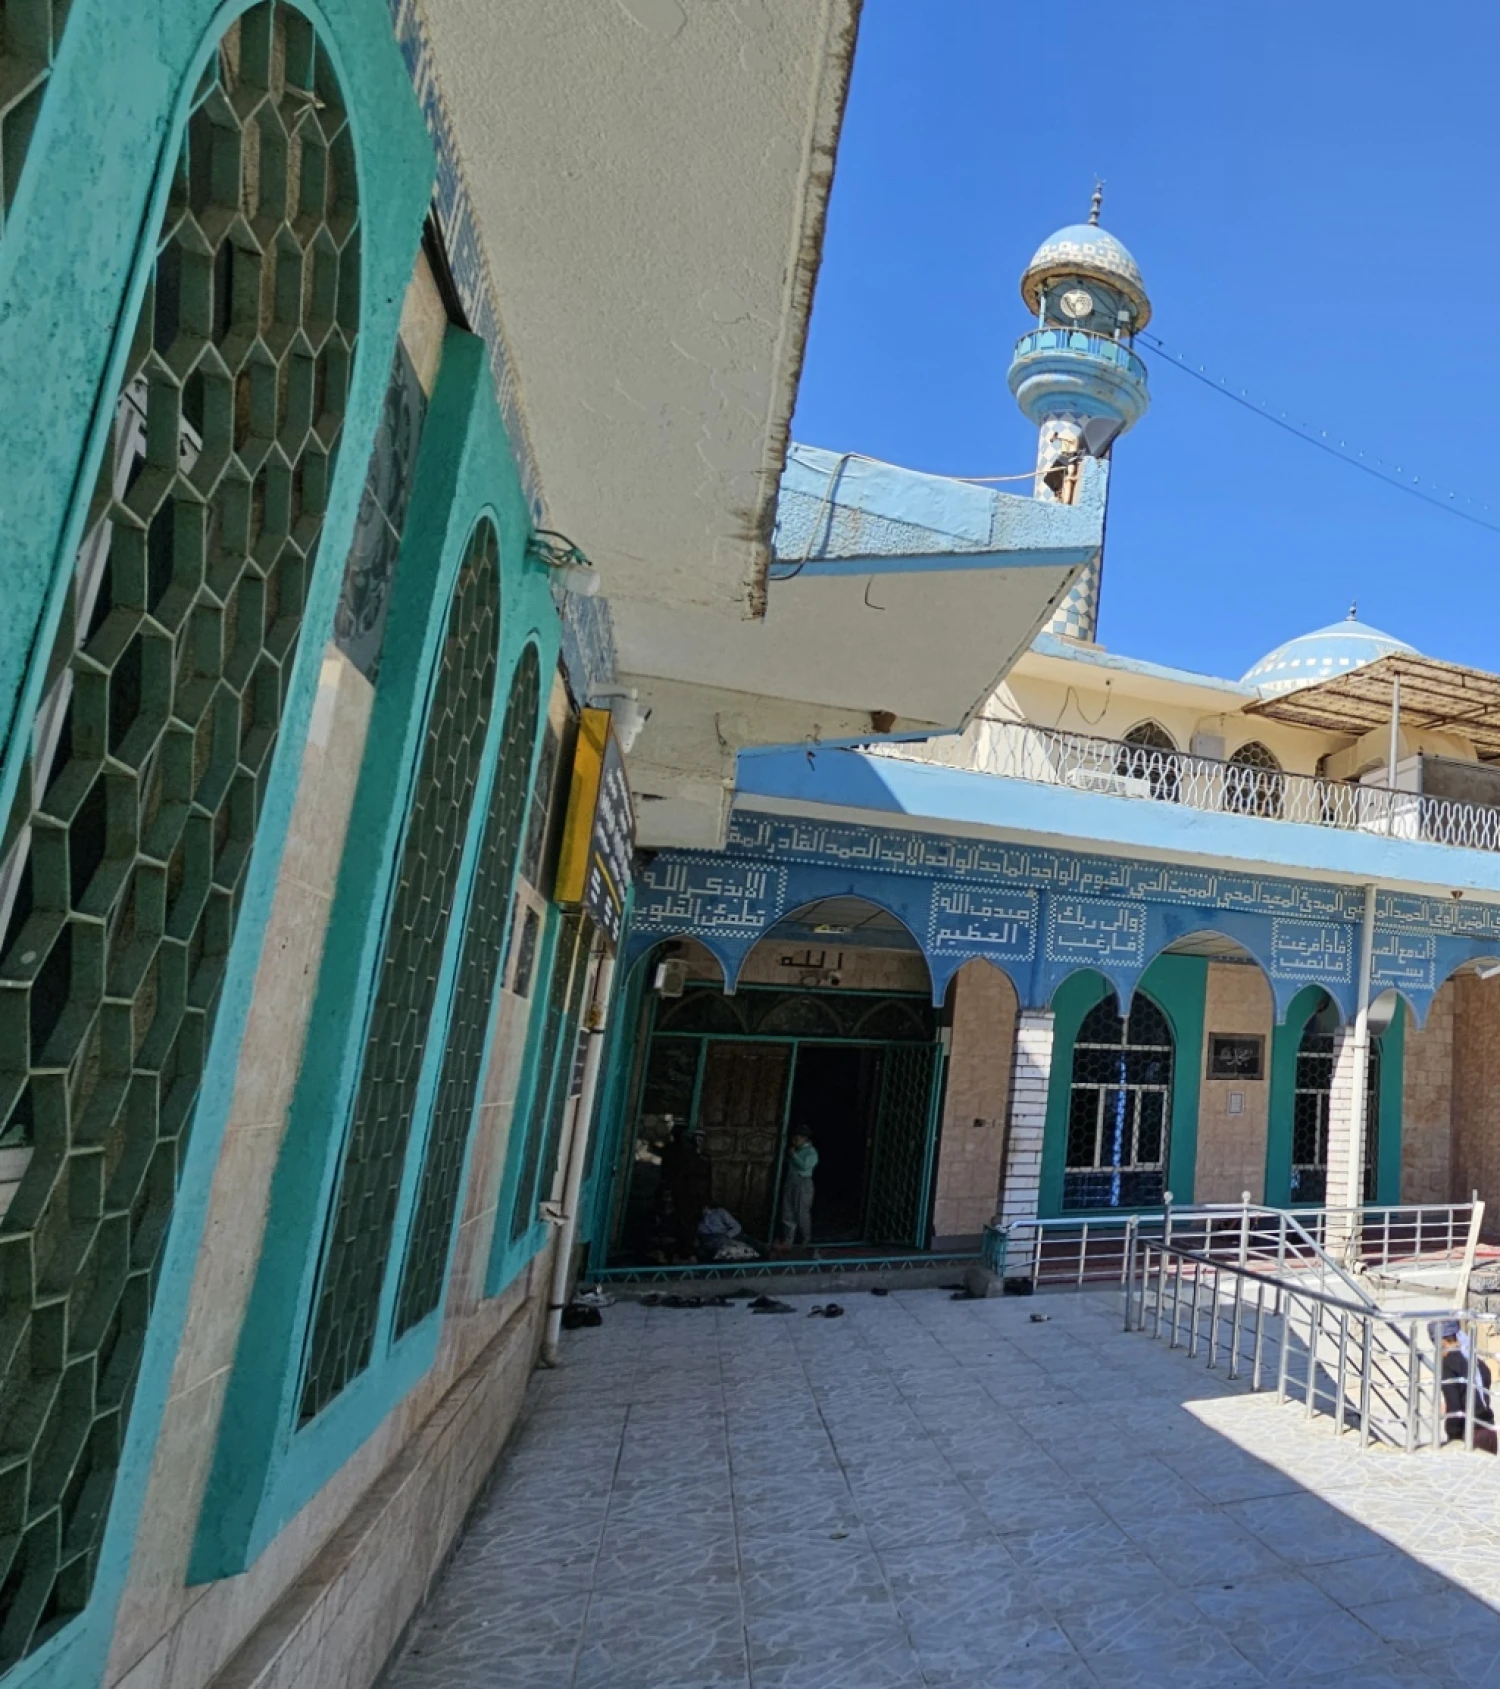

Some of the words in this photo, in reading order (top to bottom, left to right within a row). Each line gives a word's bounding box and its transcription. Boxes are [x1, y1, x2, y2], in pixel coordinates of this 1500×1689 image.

[767, 828, 825, 853] القادر
[825, 836, 881, 860] الصمد
[644, 864, 688, 893] الله
[979, 852, 1030, 879] الماجد
[1080, 866, 1130, 893] القيوم
[940, 892, 970, 914] الله
[936, 922, 1017, 948] العظيم
